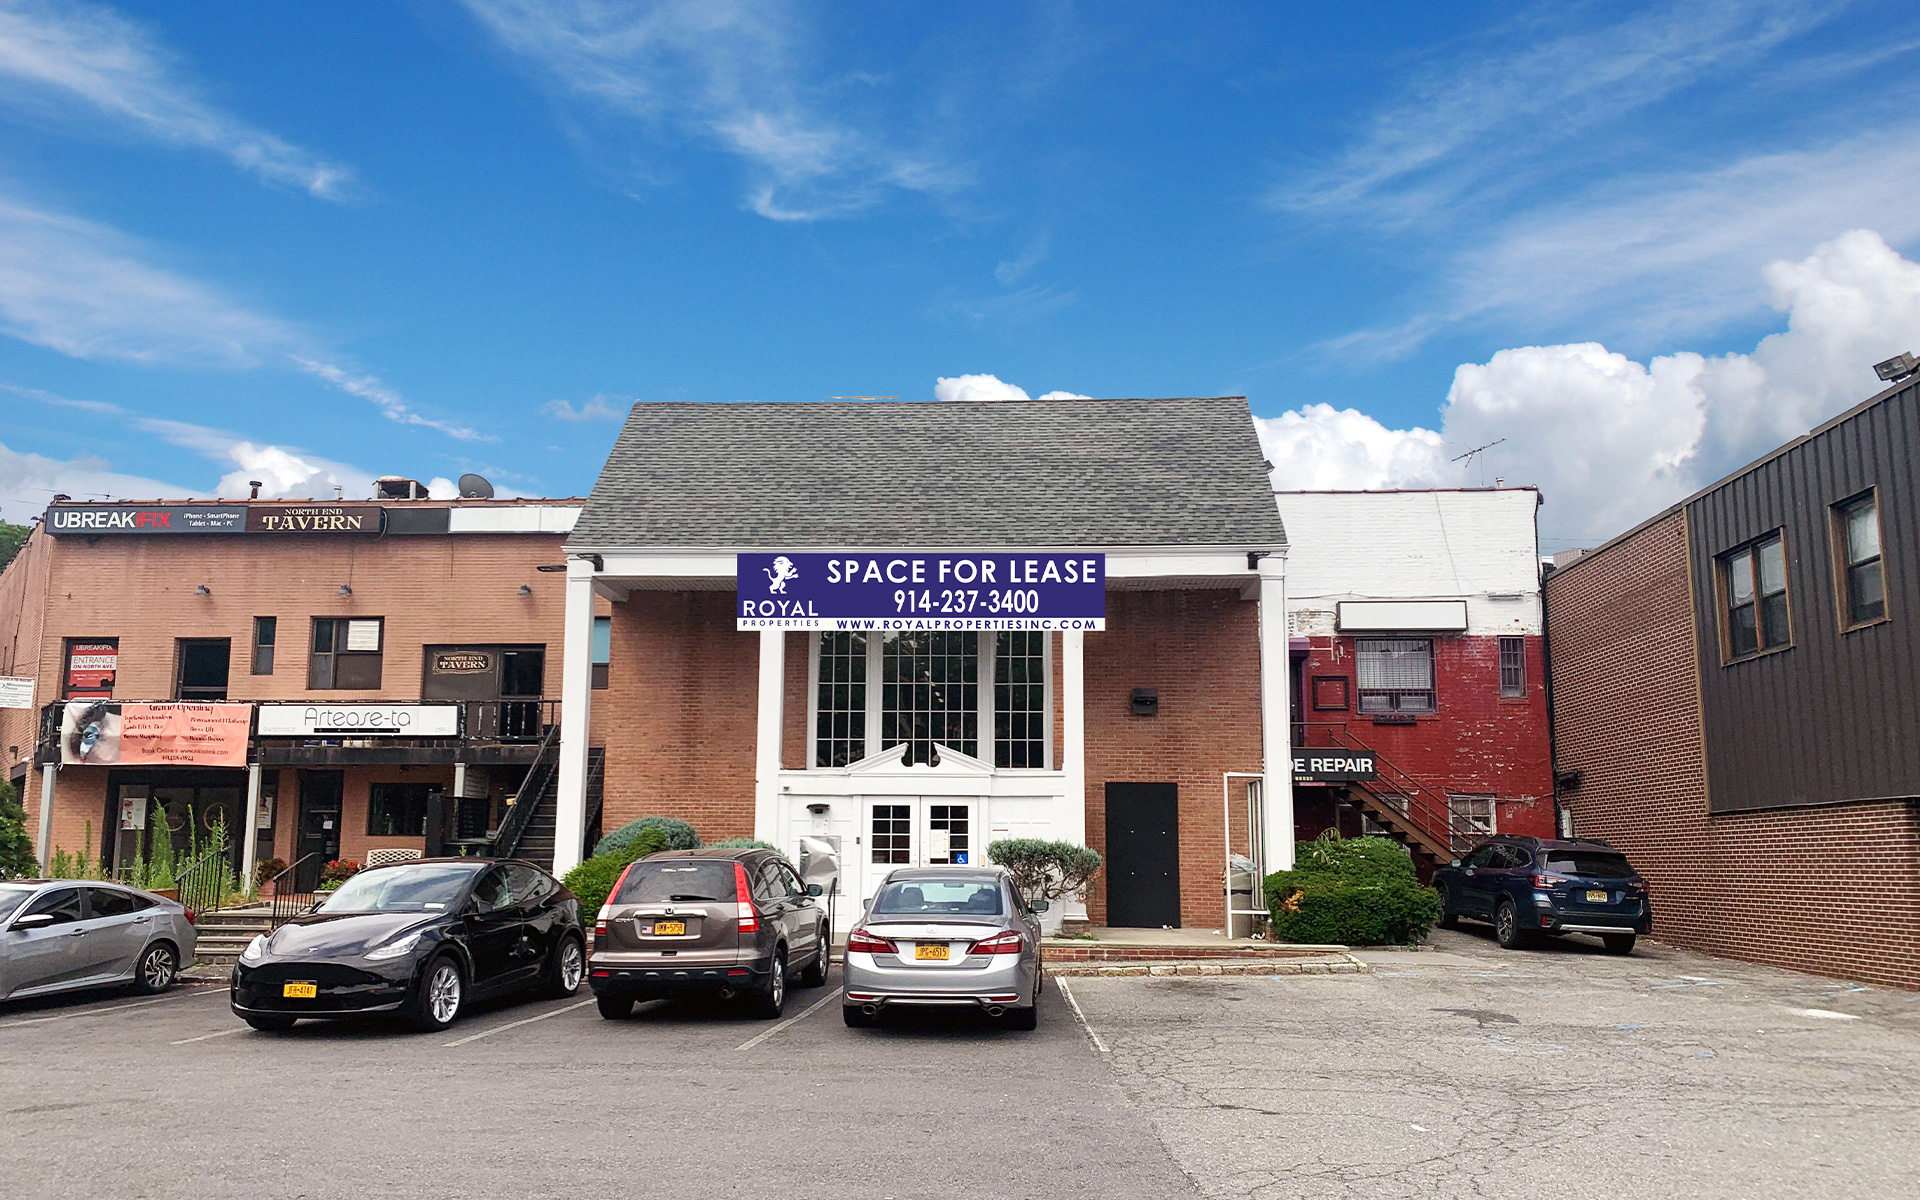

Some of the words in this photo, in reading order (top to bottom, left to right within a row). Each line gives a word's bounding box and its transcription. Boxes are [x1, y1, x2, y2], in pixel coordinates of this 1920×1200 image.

[54, 511, 172, 528] UBREAKIFIX
[284, 508, 319, 516] NORTH
[262, 515, 363, 530] TAVERN
[826, 559, 926, 584] SPACE
[939, 559, 998, 584] FOR
[1010, 559, 1096, 584] LEASE
[743, 600, 819, 617] ROYAL
[893, 589, 1040, 614] 914-237-3400
[836, 619, 1096, 630] WWW.ROYALPROPERTIESINC.COM
[73, 656, 115, 664] ENTRANCE
[440, 661, 486, 669] TAVERN
[1310, 758, 1373, 773] REPAIR
